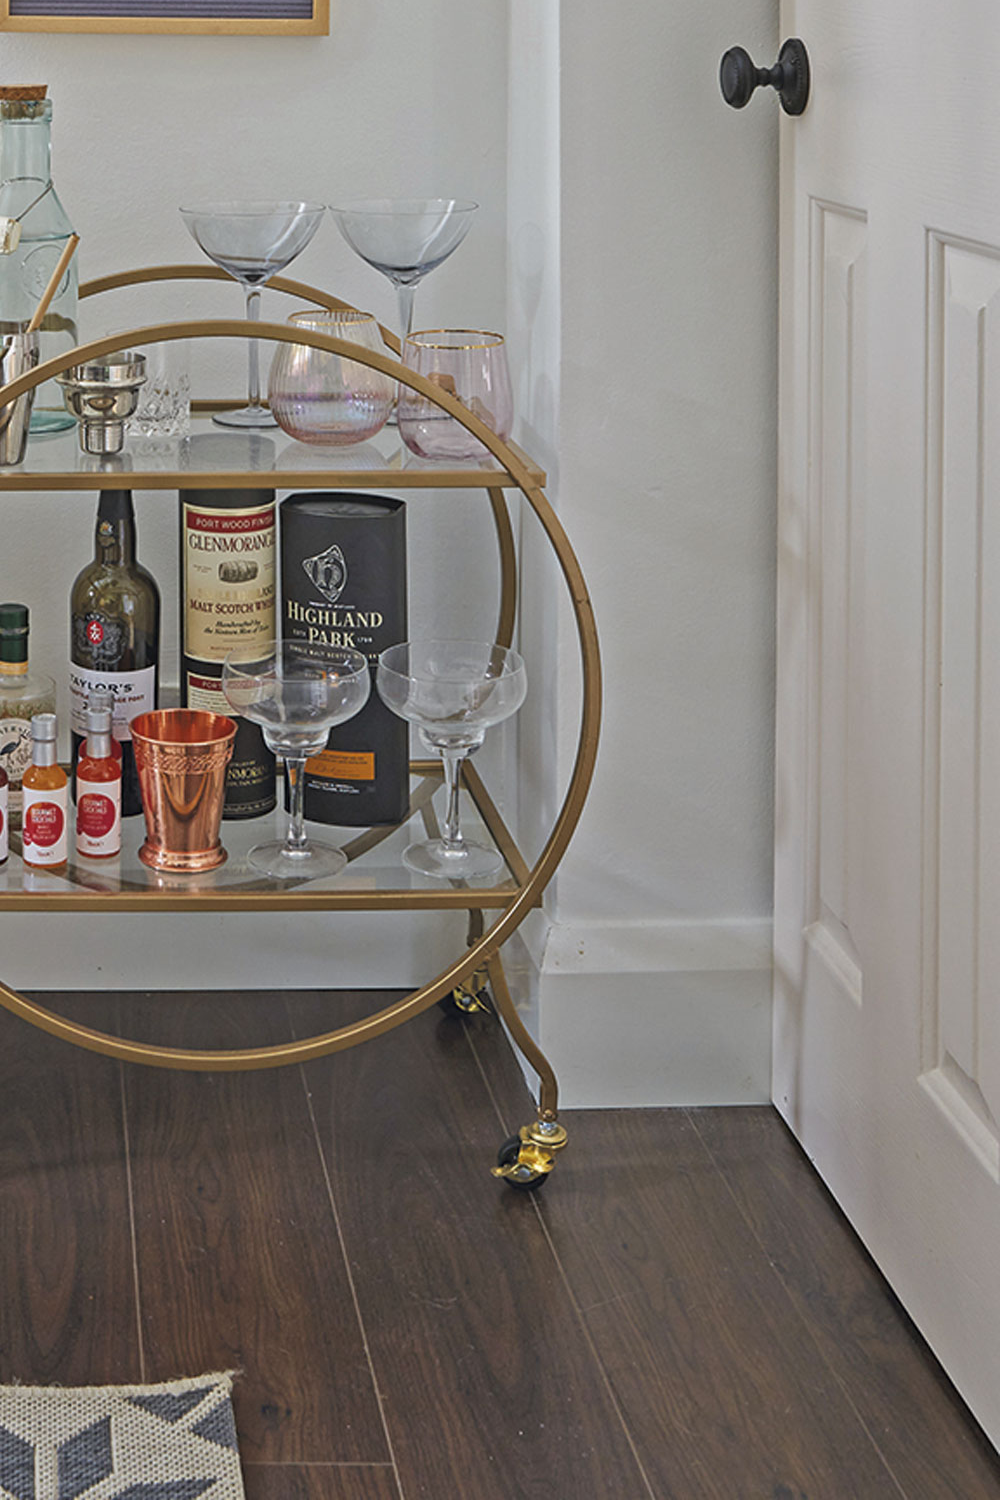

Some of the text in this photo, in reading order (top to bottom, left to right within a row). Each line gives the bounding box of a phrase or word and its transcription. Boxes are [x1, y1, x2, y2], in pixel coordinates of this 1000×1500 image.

[196, 517, 219, 528] PORT
[222, 520, 250, 529] WOOD
[190, 599, 213, 613] MALT
[215, 602, 254, 614] SCOTCH
[287, 600, 383, 628] HIGHLAND
[308, 627, 356, 648] PARK
[70, 673, 133, 695] TAYLOR'S
